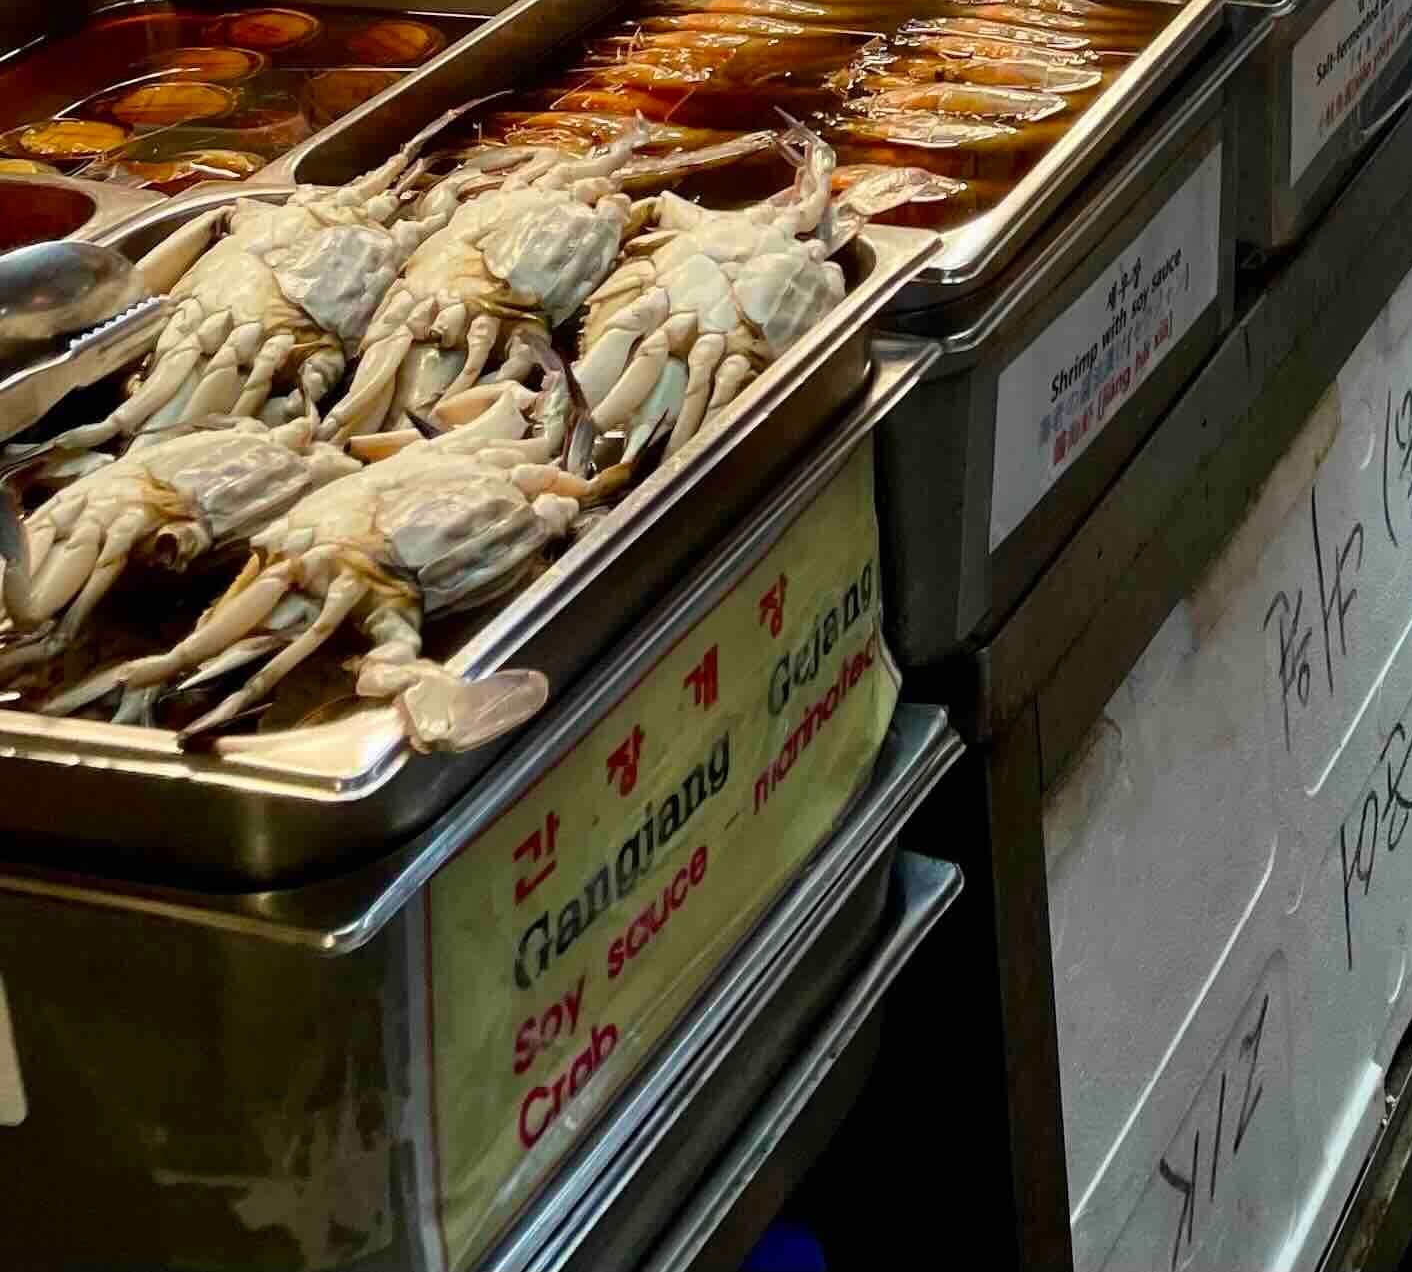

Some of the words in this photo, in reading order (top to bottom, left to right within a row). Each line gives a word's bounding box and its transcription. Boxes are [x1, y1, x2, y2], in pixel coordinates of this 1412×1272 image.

[1051, 342, 1098, 403] Shrimp
[1102, 307, 1128, 348] with
[1152, 248, 1182, 288] sauce
[766, 560, 875, 719] Gejang
[607, 845, 708, 979] sauce
[518, 1022, 618, 1152] Crab
